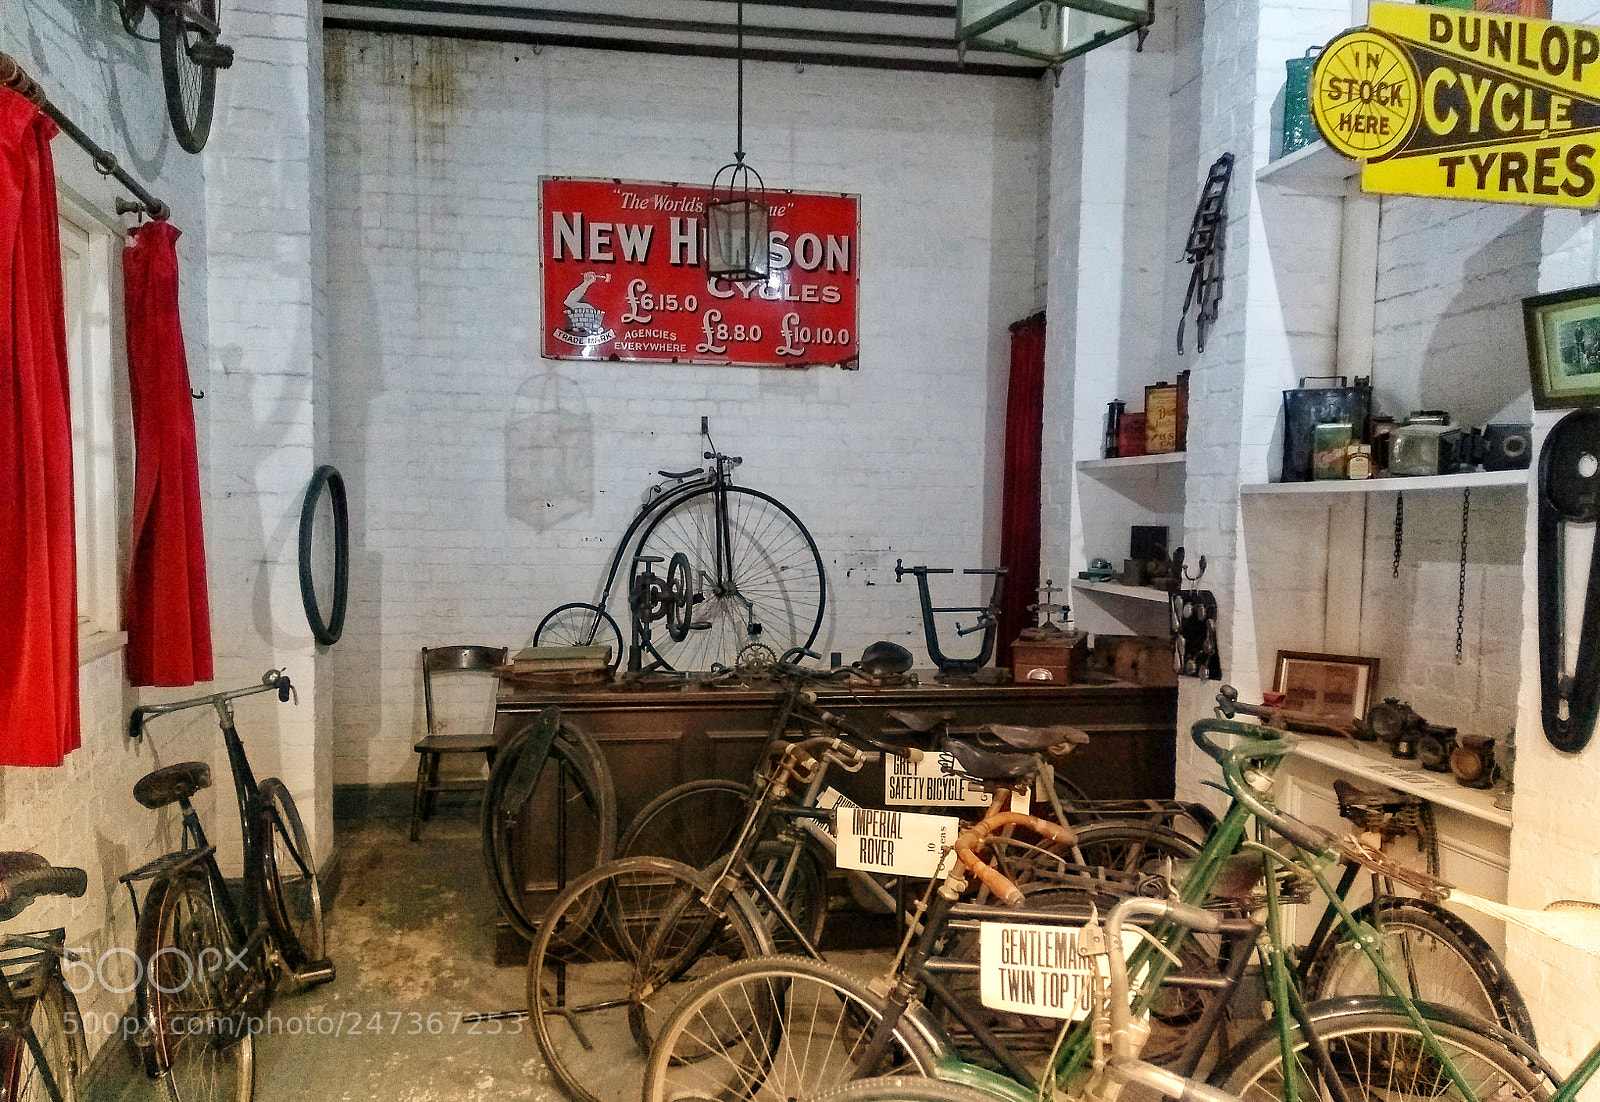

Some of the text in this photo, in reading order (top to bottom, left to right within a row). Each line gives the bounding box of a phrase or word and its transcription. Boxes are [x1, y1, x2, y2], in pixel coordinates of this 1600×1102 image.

[1354, 51, 1381, 69] IN
[1429, 13, 1600, 82] DUNLOP
[1327, 77, 1404, 108] STOCK
[1424, 66, 1572, 136] CYCLE
[1339, 112, 1390, 135] HERE
[1439, 144, 1596, 198] TYRES
[653, 193, 704, 213] World's
[552, 211, 850, 273] NEW HSON
[621, 278, 699, 324] £6.15.0
[707, 276, 841, 303] CYCLES
[557, 331, 612, 345] TRADE MARK
[624, 329, 677, 341] AGENCIES
[695, 308, 762, 354] £8.8.0
[775, 312, 850, 356] £10.10.0
[614, 342, 687, 352] EVERYWHERE
[889, 776, 965, 801] SAFETY BICYCLE
[852, 809, 903, 840] IMPERIAL
[859, 838, 895, 867] ROVER
[1001, 928, 1096, 971] GENTLEMA
[998, 967, 1036, 1005] TWIN
[1041, 971, 1070, 1009] TOP
